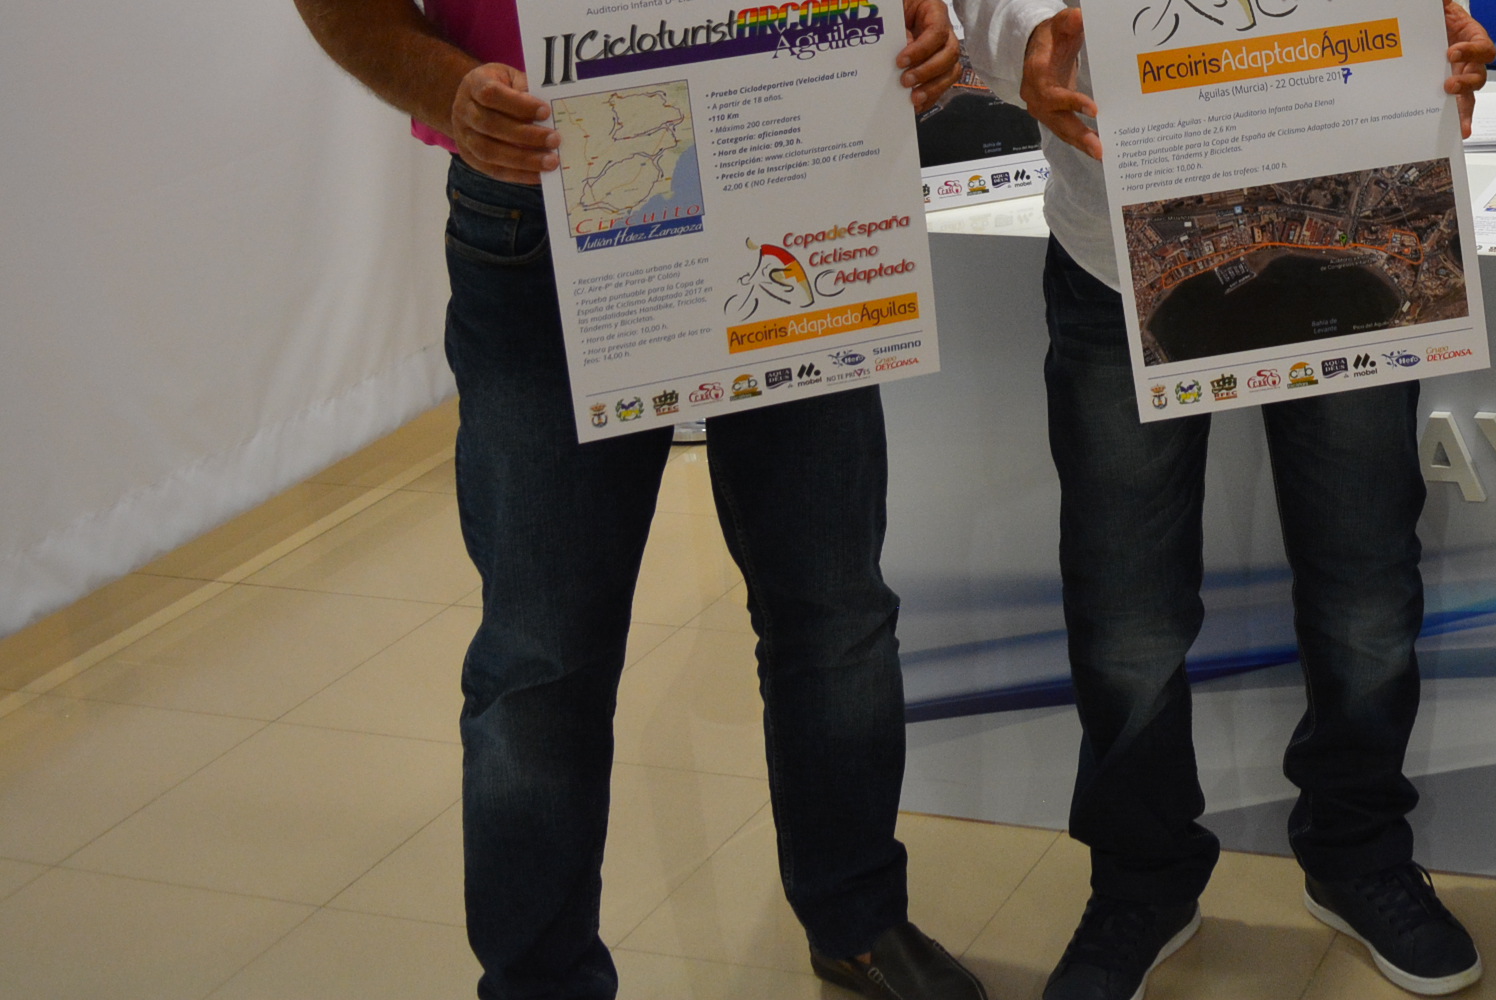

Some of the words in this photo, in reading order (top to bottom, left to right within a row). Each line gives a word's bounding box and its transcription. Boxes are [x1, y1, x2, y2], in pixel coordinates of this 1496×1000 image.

[585, 4, 629, 15] Auditorio
[630, 0, 663, 9] Infanta
[772, 22, 881, 61] Águilas
[710, 88, 738, 98] Prueba
[738, 80, 794, 94] Ciclodeportiva
[795, 72, 835, 86] (Velocidad
[835, 69, 858, 79] Libre)
[1198, 87, 1230, 102] Águilas
[1231, 81, 1268, 96] (Murcia)
[1275, 78, 1286, 89] 22
[1287, 74, 1324, 87] Octubre
[711, 102, 717, 110] A
[718, 100, 740, 111] partir
[741, 98, 751, 106] de
[753, 95, 762, 103] 18
[763, 94, 782, 102] años.
[714, 123, 745, 133] Máximo
[746, 120, 761, 129] 200
[761, 114, 801, 126] corredores
[715, 133, 755, 145] Categoría:
[757, 126, 801, 140] aficionados
[1118, 136, 1154, 147] Recorrido:
[1156, 132, 1183, 142] circuito
[1183, 130, 1202, 138] llano
[1201, 127, 1212, 136] de
[1212, 125, 1224, 134] 2,6
[1223, 124, 1237, 132] Km
[1014, 181, 1032, 189] mobel
[576, 204, 700, 234] Circuito
[578, 235, 613, 252] Julián
[648, 223, 703, 239] Zaragoza
[808, 242, 878, 267] Ciclismo
[833, 257, 916, 288] Adaptado
[872, 338, 922, 356] SHIMANO
[1426, 349, 1472, 362] DEYCONSA
[874, 356, 919, 372] DEYCONSA
[1353, 368, 1377, 378] mobel
